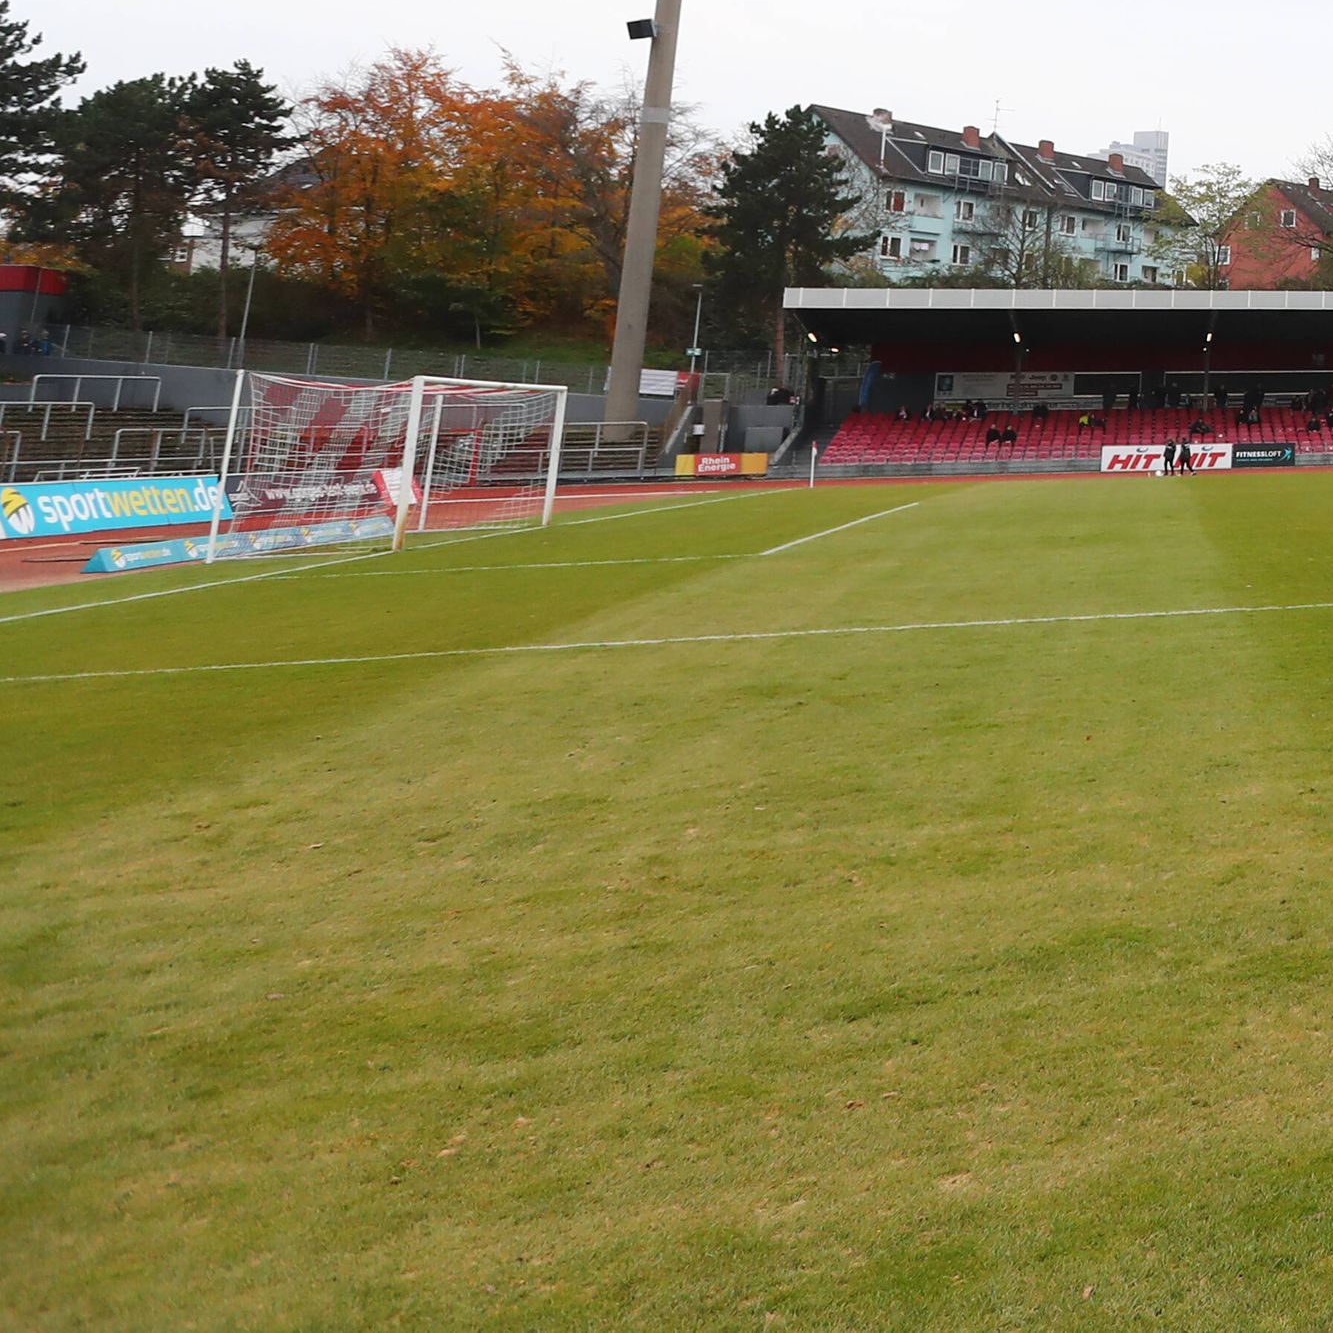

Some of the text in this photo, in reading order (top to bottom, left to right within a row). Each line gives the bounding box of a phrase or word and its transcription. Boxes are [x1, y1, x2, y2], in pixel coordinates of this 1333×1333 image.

[1235, 450, 1282, 458] FITNESSLOFT
[701, 457, 730, 465] Rhein
[1107, 454, 1161, 470] HIT
[698, 463, 737, 473] Energie
[38, 479, 225, 532] sportwetten.de
